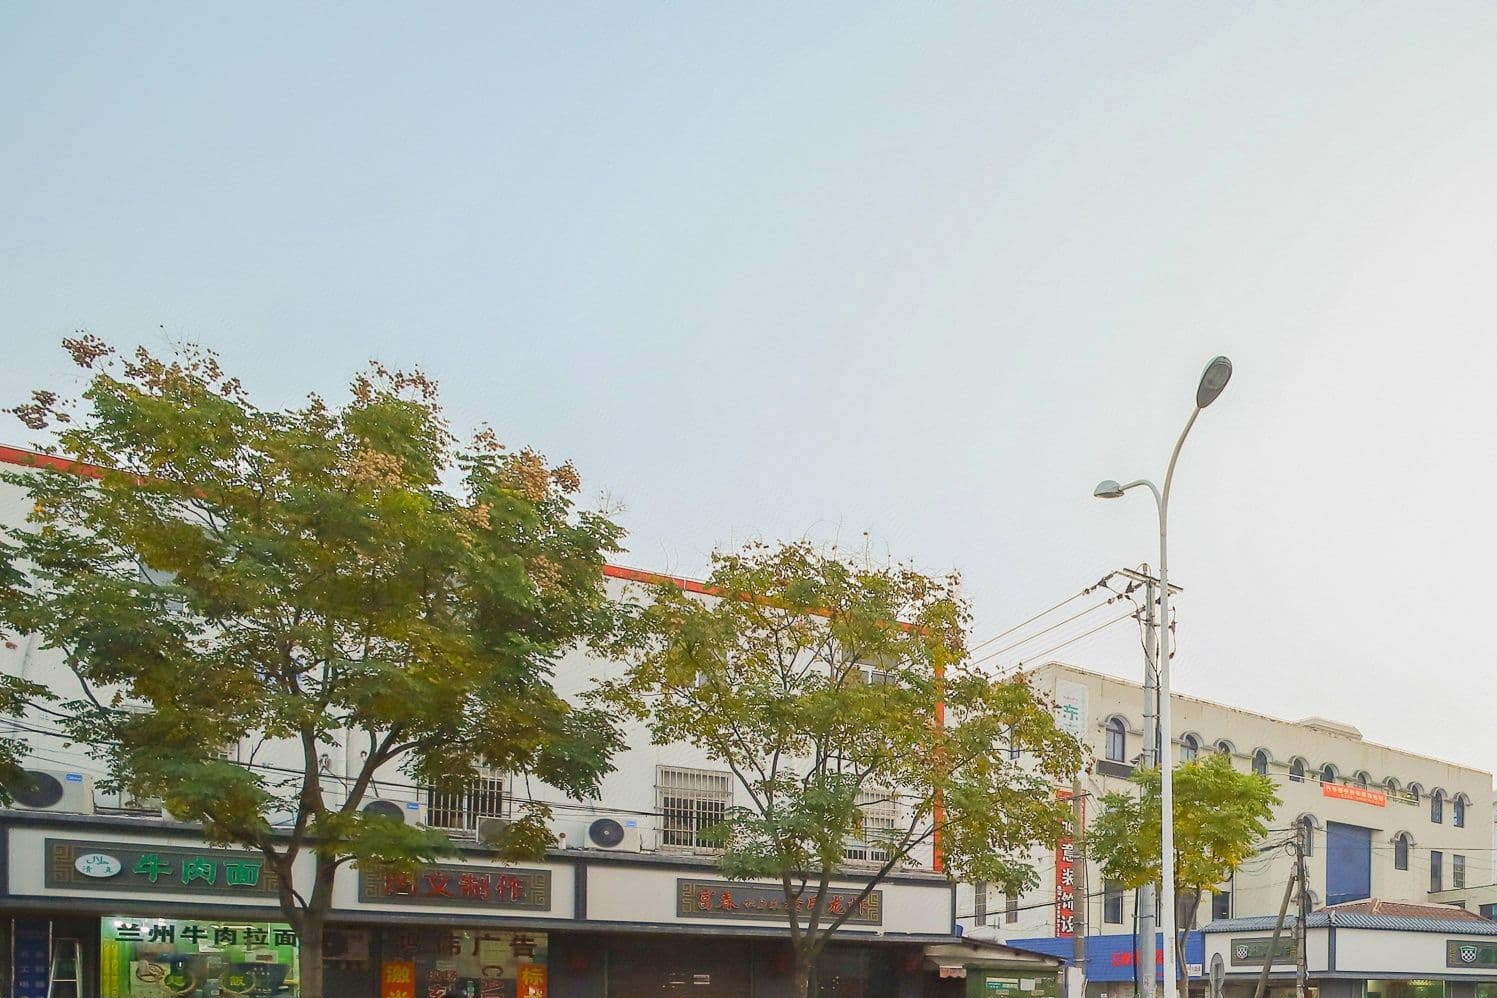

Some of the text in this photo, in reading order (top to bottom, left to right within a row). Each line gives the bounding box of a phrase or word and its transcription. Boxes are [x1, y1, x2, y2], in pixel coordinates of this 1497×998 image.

[131, 853, 262, 887] 牛肉面
[115, 923, 296, 948] 兰州牛肉拉面
